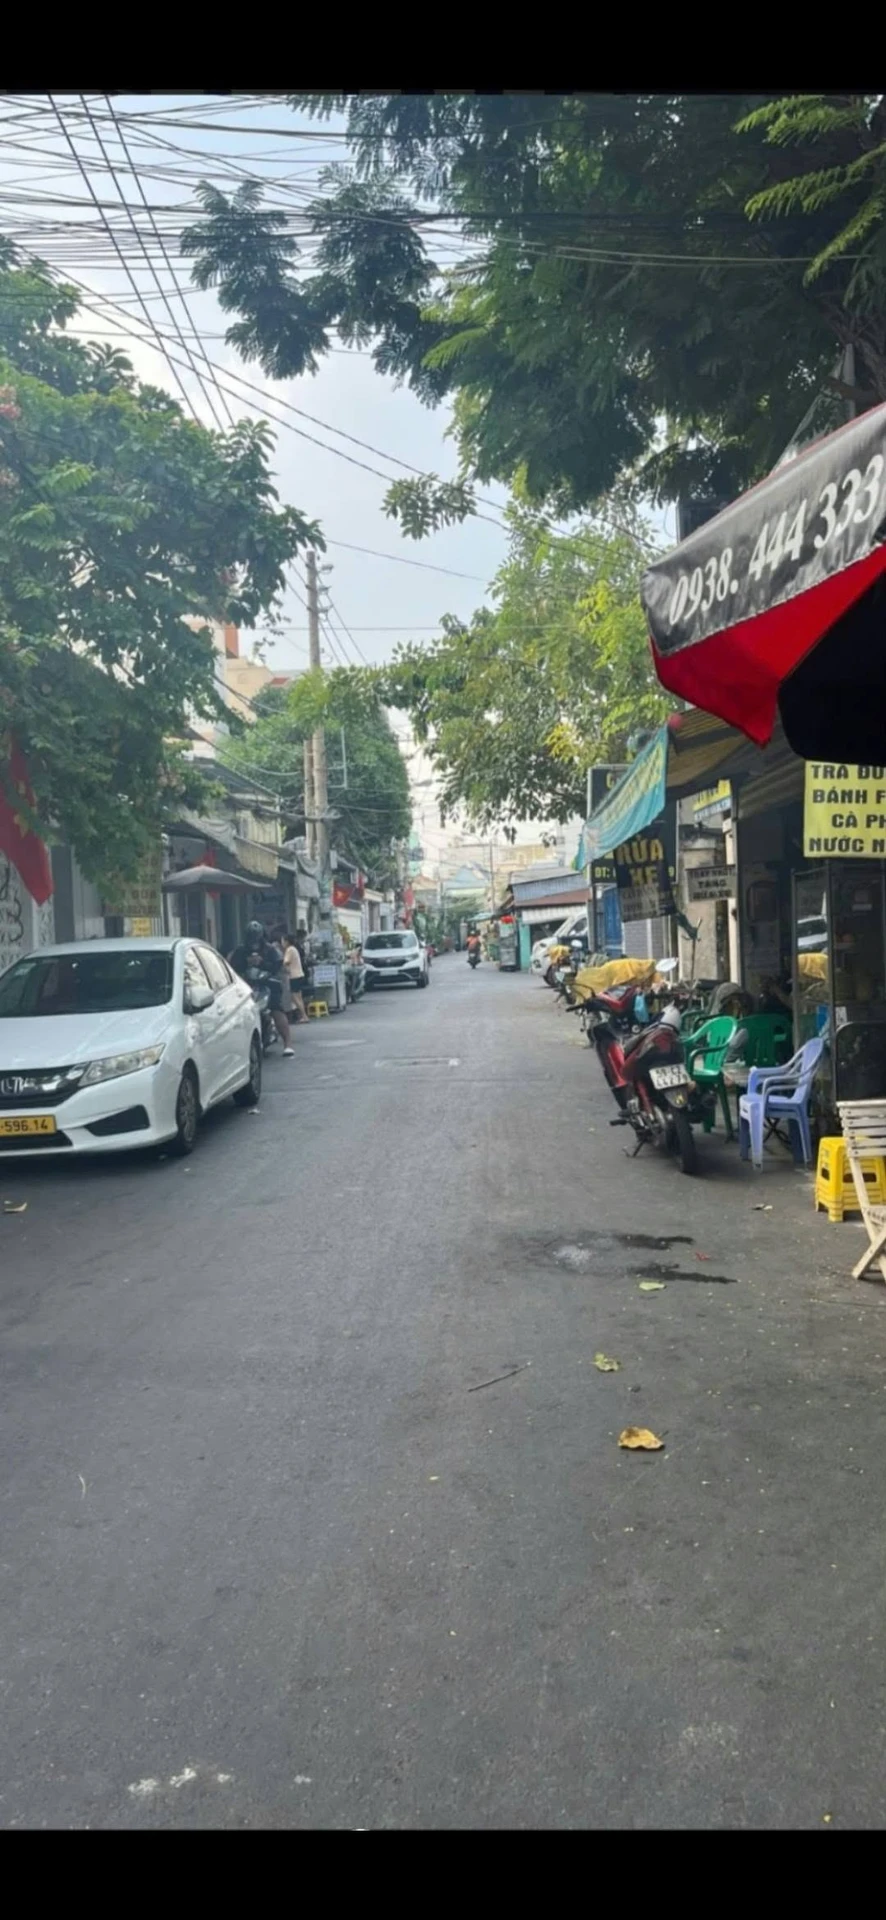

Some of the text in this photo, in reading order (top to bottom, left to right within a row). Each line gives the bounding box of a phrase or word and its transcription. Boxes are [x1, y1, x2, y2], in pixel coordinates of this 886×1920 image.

[669, 454, 884, 625] 0938. 444 333
[813, 786, 867, 804] BÁNH
[832, 811, 858, 828] CÀ
[809, 835, 865, 853] NƯỚC
